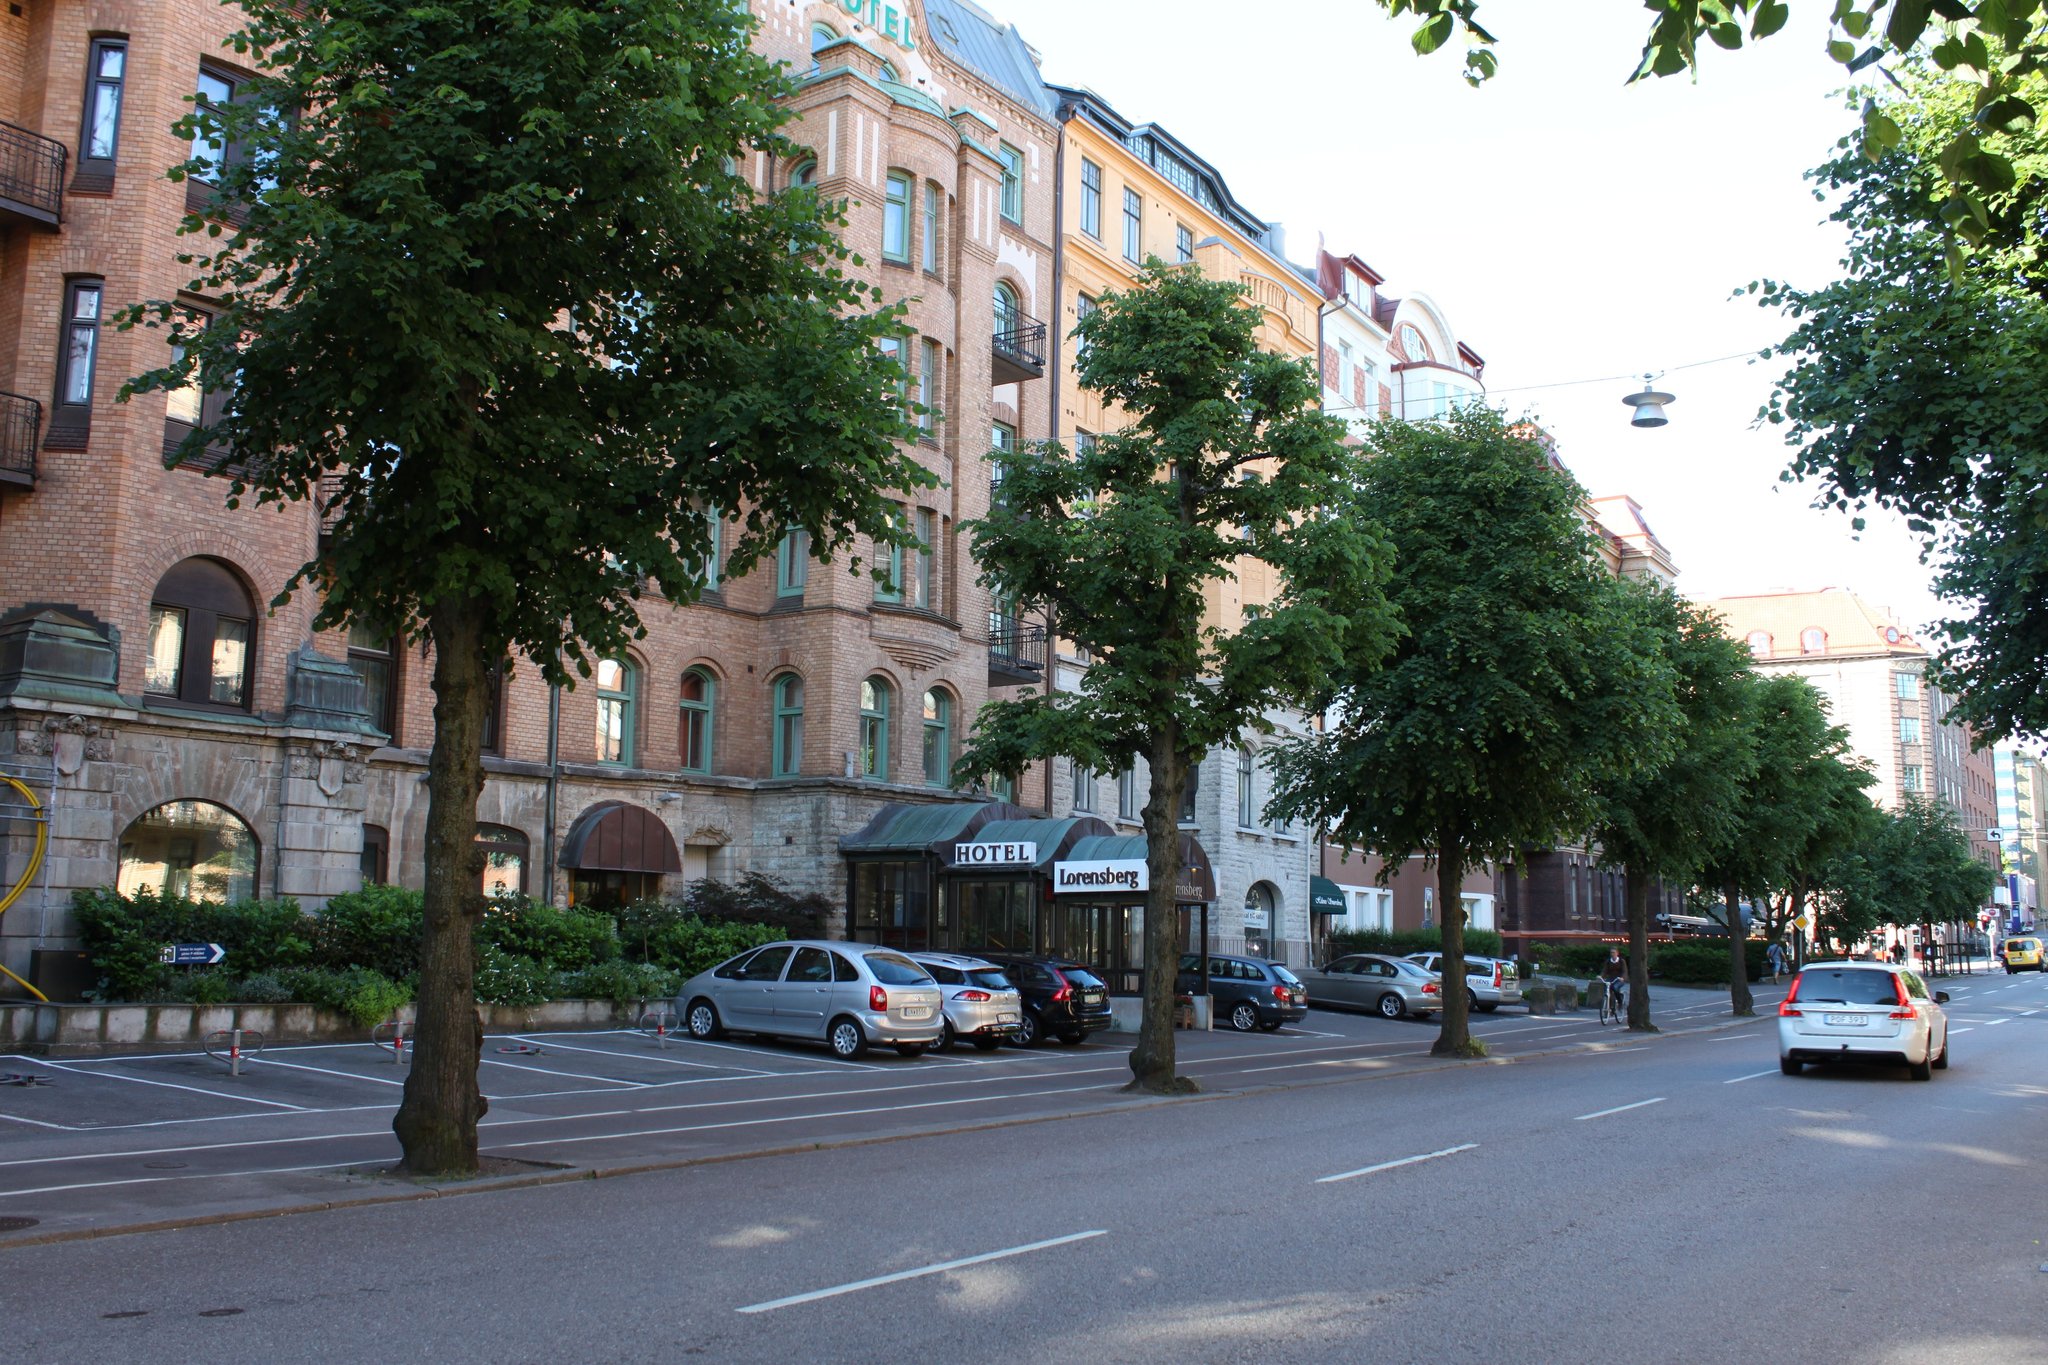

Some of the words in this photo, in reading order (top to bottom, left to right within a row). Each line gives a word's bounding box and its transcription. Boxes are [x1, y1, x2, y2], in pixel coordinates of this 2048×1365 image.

[956, 844, 1030, 863] HOTEL
[1059, 867, 1139, 888] Lorensberg
[1175, 880, 1203, 900] rensberg
